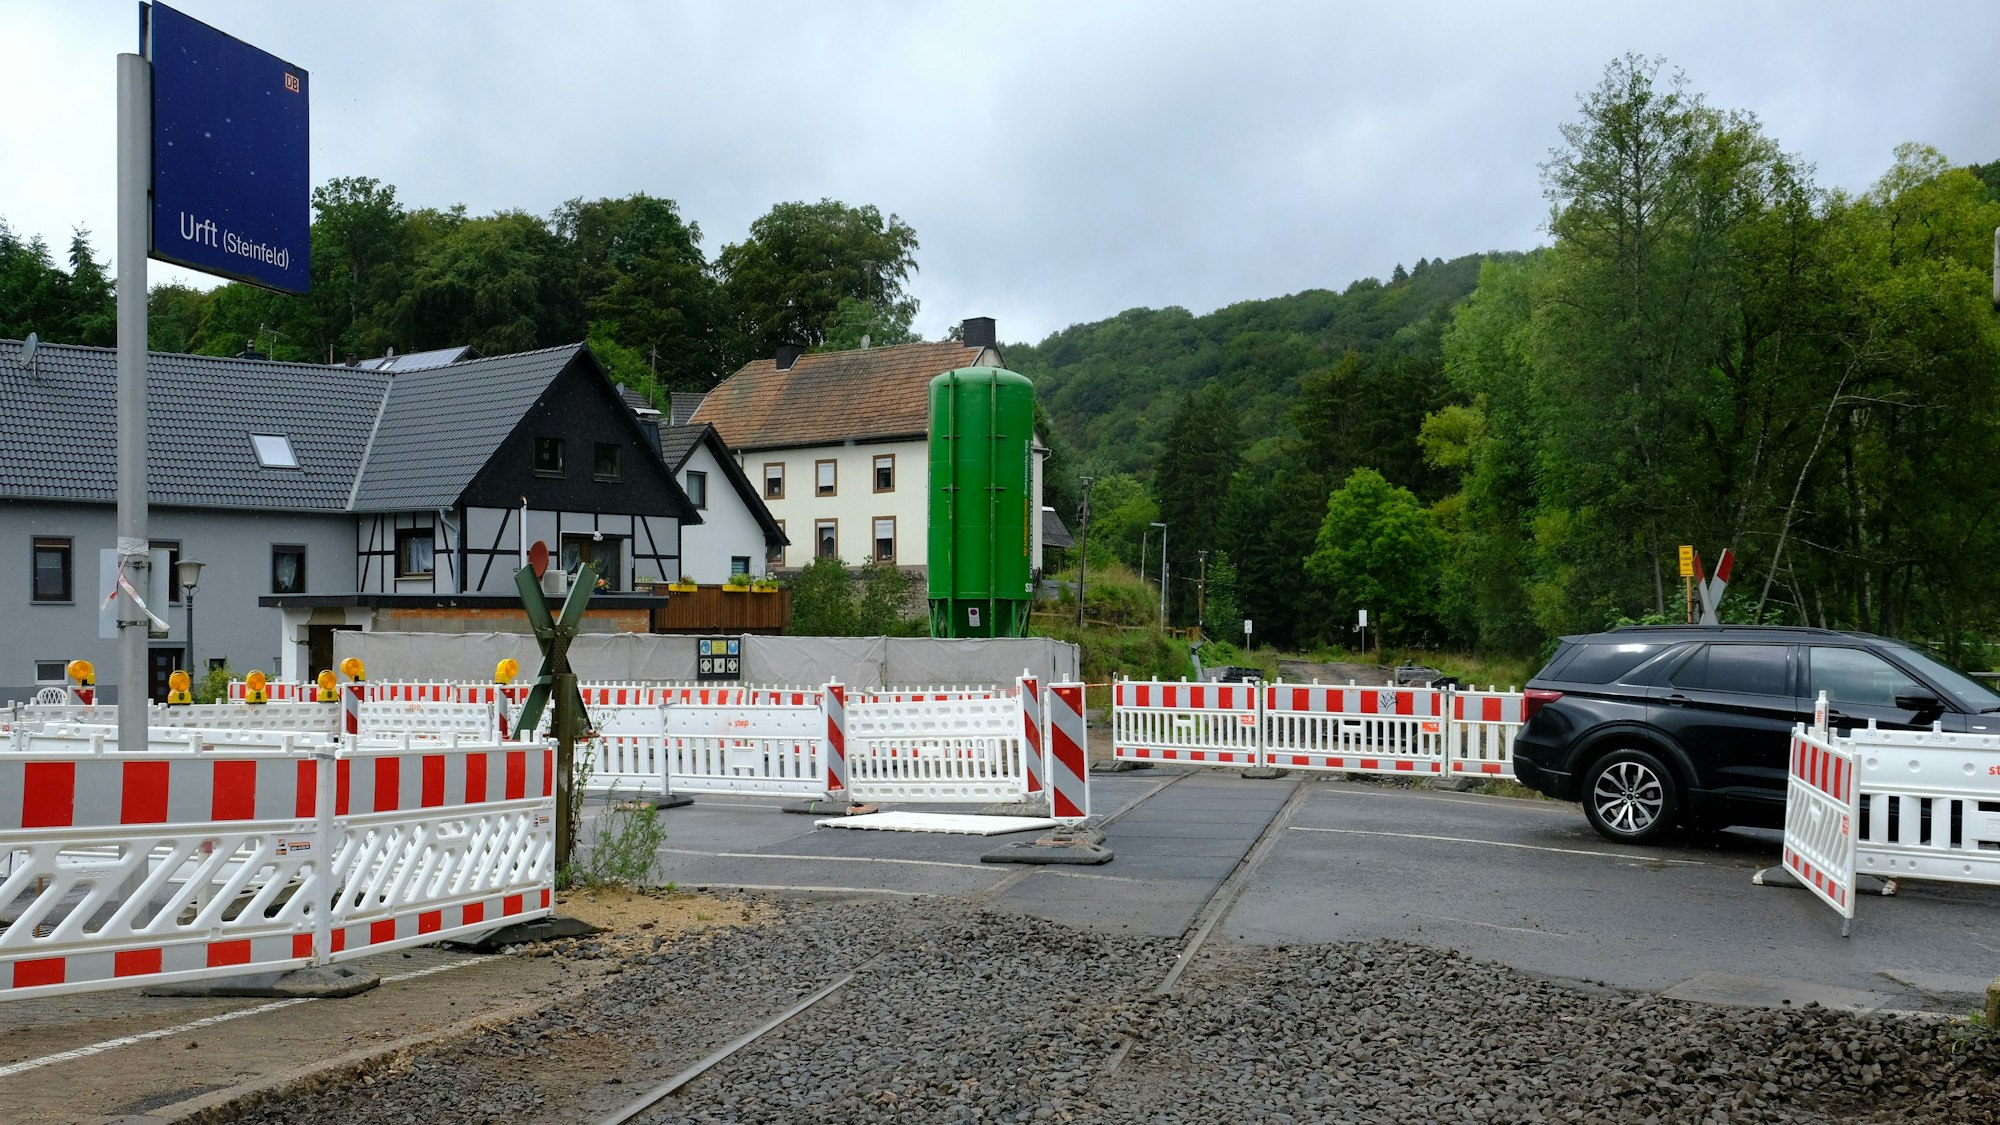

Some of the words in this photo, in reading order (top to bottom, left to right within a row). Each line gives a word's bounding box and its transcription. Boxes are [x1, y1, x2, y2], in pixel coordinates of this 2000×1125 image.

[180, 211, 218, 248] Urft
[223, 229, 289, 270] (Steinfeld)
[734, 719, 749, 728] step
